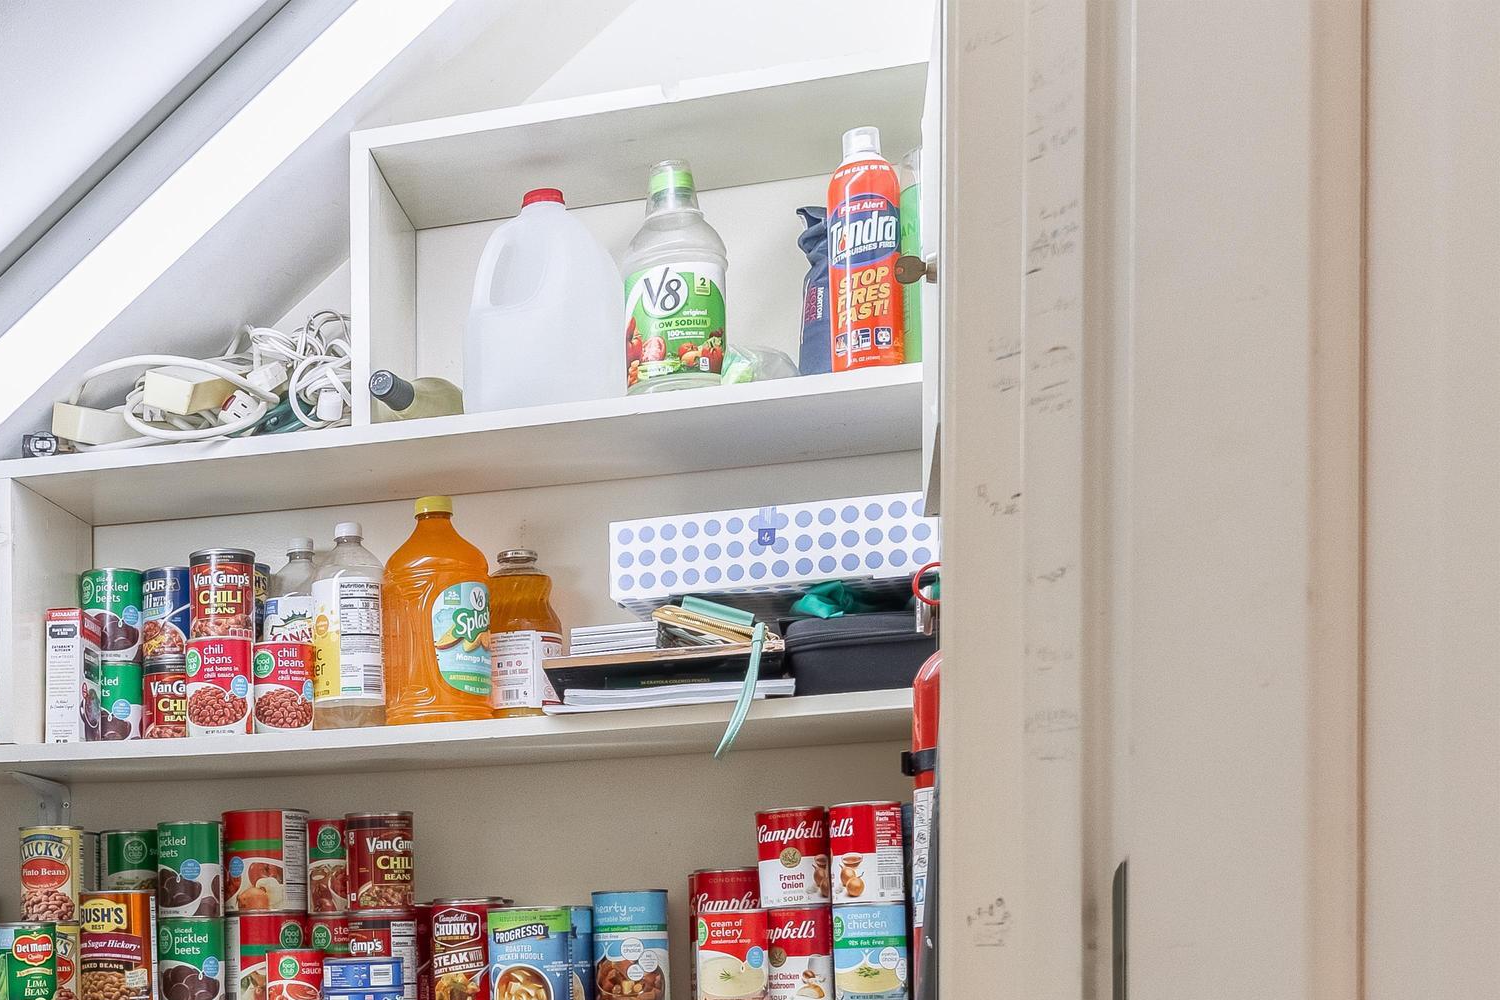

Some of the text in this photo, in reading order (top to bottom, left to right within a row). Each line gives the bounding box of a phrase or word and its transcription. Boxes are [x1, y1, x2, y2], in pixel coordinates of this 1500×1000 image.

[861, 201, 884, 210] Alert
[839, 266, 889, 295] STOP
[644, 267, 681, 311] V8
[838, 300, 890, 329] FAST!
[675, 318, 708, 327] SODIUM
[95, 582, 129, 595] pickled
[199, 590, 242, 604] CHILI
[203, 645, 224, 655] chili
[278, 648, 298, 658] chili
[203, 656, 232, 664] beans
[278, 658, 305, 667] beans
[321, 833, 336, 841] food
[22, 842, 65, 860] LUCK'S
[40, 868, 66, 876] Beans
[779, 873, 805, 881] French
[781, 881, 804, 889] Onion
[81, 907, 124, 926] BUSH'S
[435, 922, 477, 936] CHUNKY
[711, 920, 733, 928] cream
[847, 920, 887, 929] chicken
[285, 929, 300, 937] food
[495, 925, 544, 943] PROGRESSO
[711, 927, 743, 938] celery
[175, 934, 209, 946] pickled
[16, 944, 29, 953] Del
[107, 940, 137, 951] Hickory
[175, 945, 201, 955] beets
[505, 945, 532, 953] ROASTED
[434, 952, 469, 969] STEAK
[301, 967, 322, 975] sauce
[26, 980, 47, 988] LIMA
[24, 987, 49, 997] BEANS
